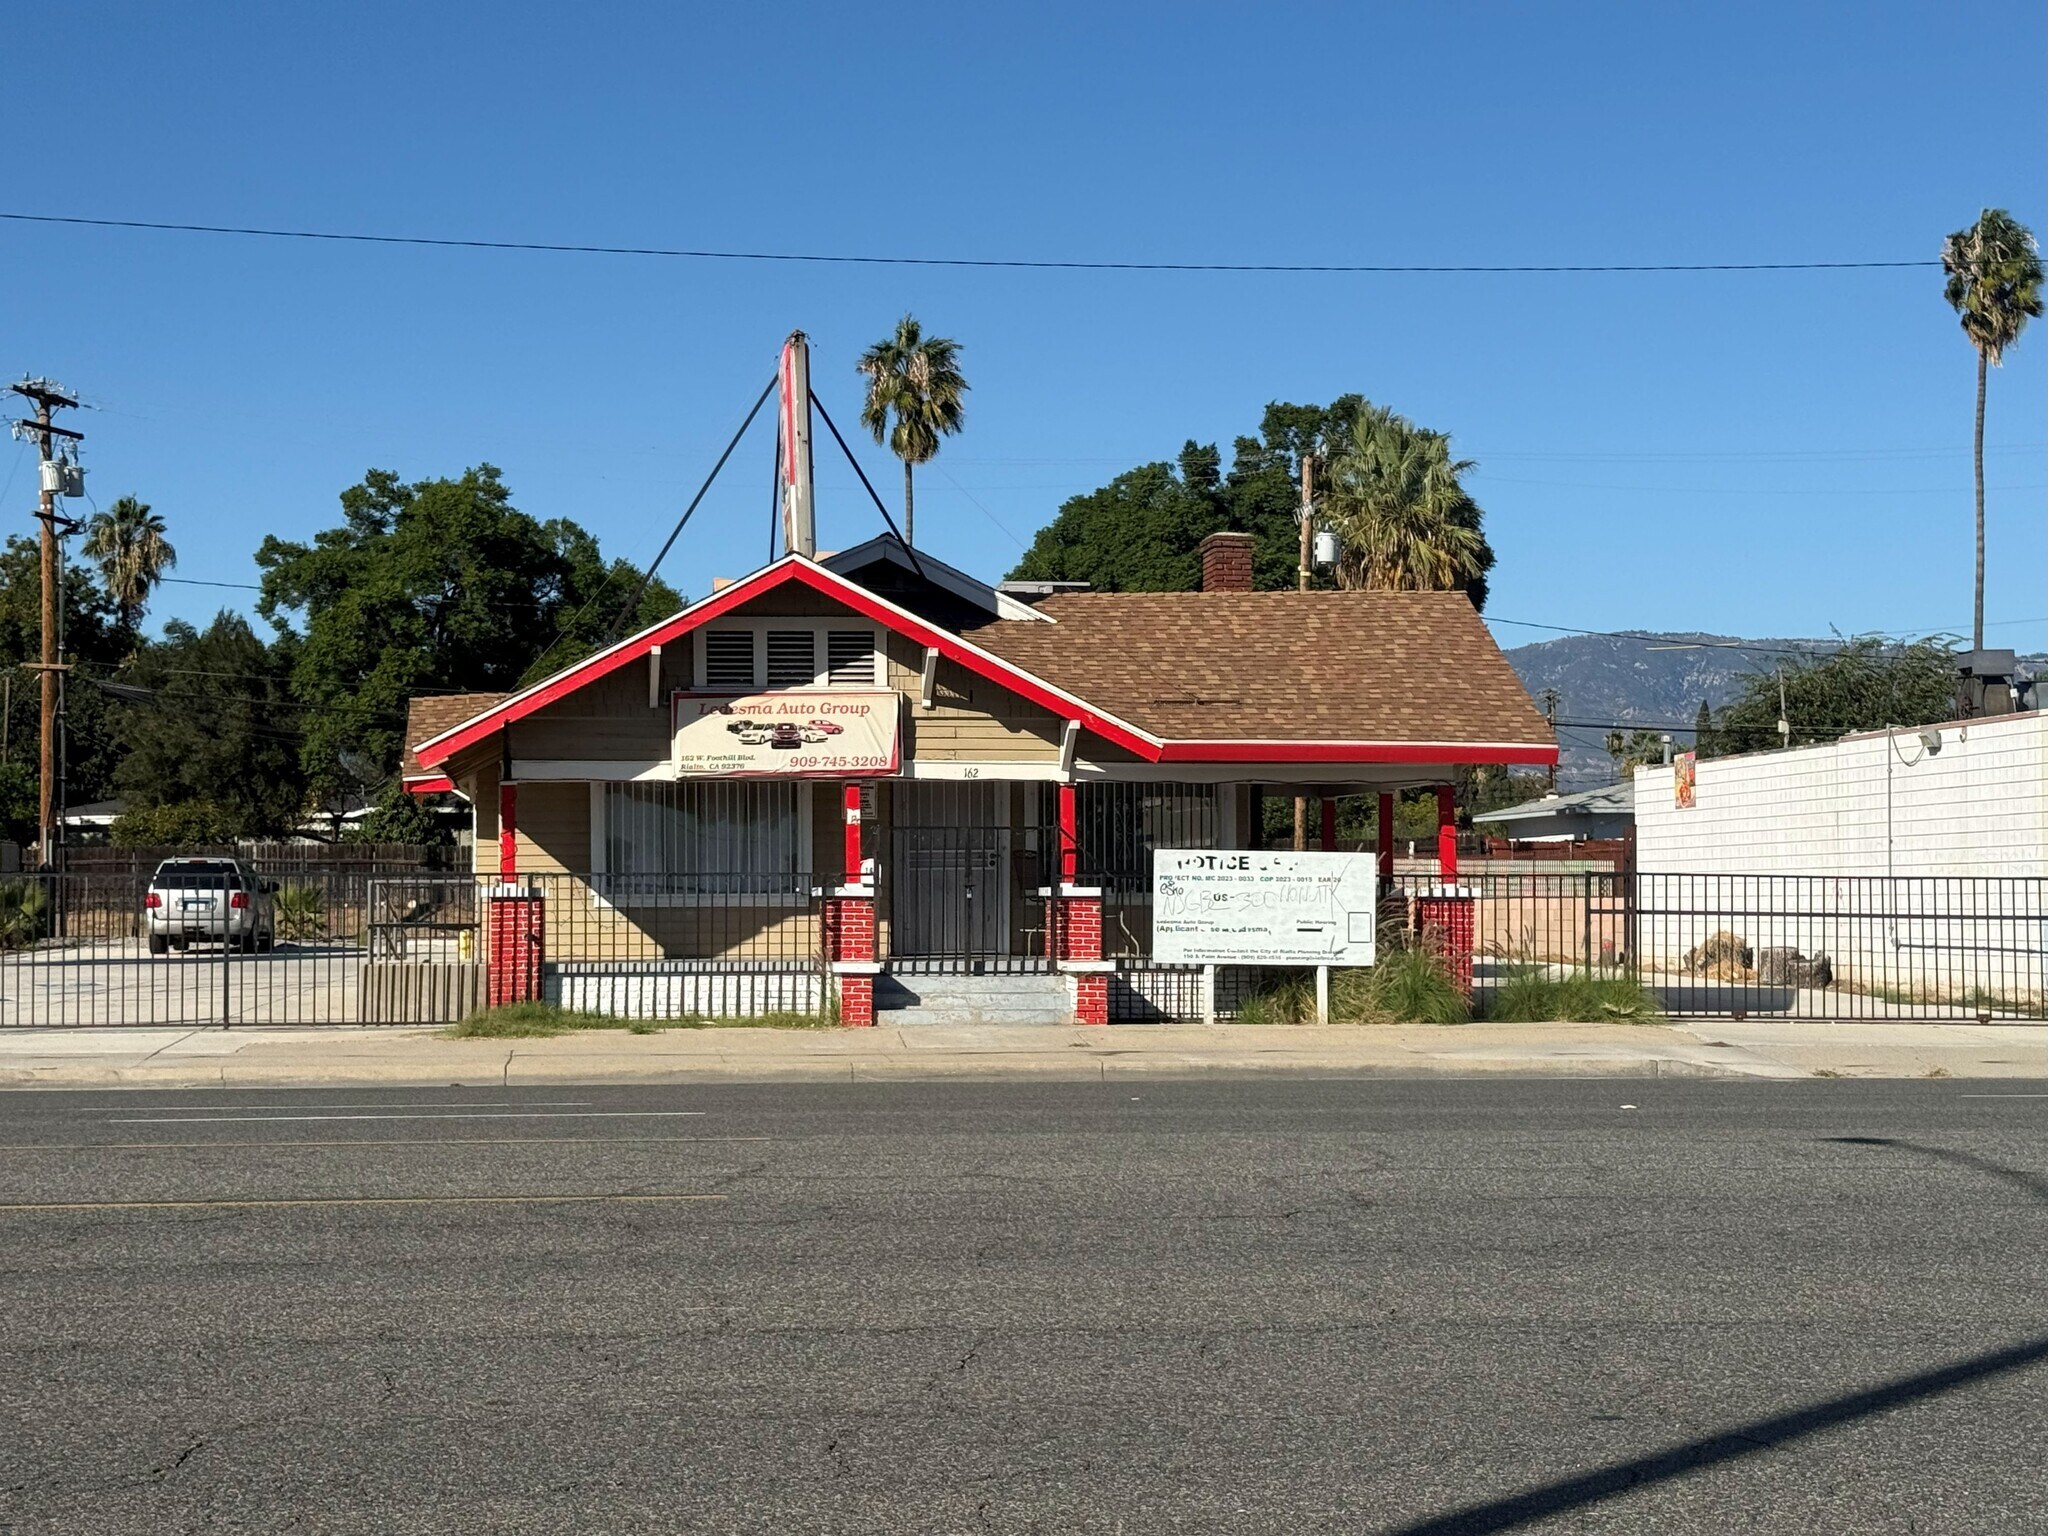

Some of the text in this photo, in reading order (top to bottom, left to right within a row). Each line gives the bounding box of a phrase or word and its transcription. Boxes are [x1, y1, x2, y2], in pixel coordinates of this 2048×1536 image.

[698, 702, 871, 717] Ledesma Auto Group
[789, 756, 888, 767] 909-745-3208
[964, 768, 979, 778] 162
